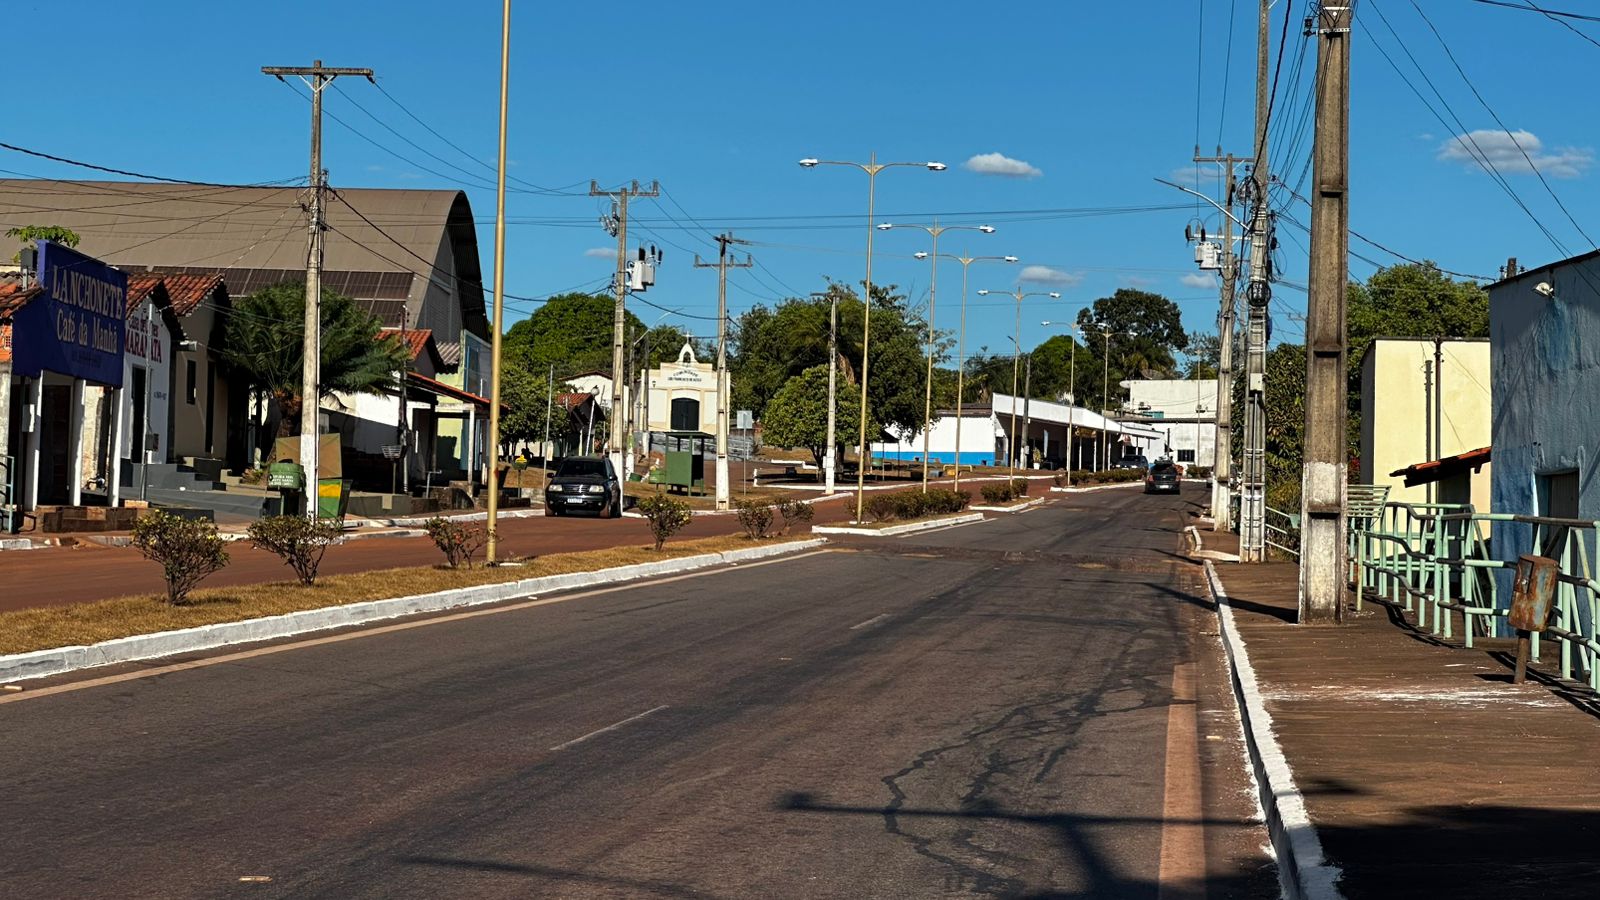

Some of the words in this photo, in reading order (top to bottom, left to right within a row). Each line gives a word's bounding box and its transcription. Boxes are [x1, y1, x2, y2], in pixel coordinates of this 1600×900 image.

[52, 265, 123, 320] LANCHONETE
[57, 308, 76, 342] Café
[78, 314, 88, 346] da
